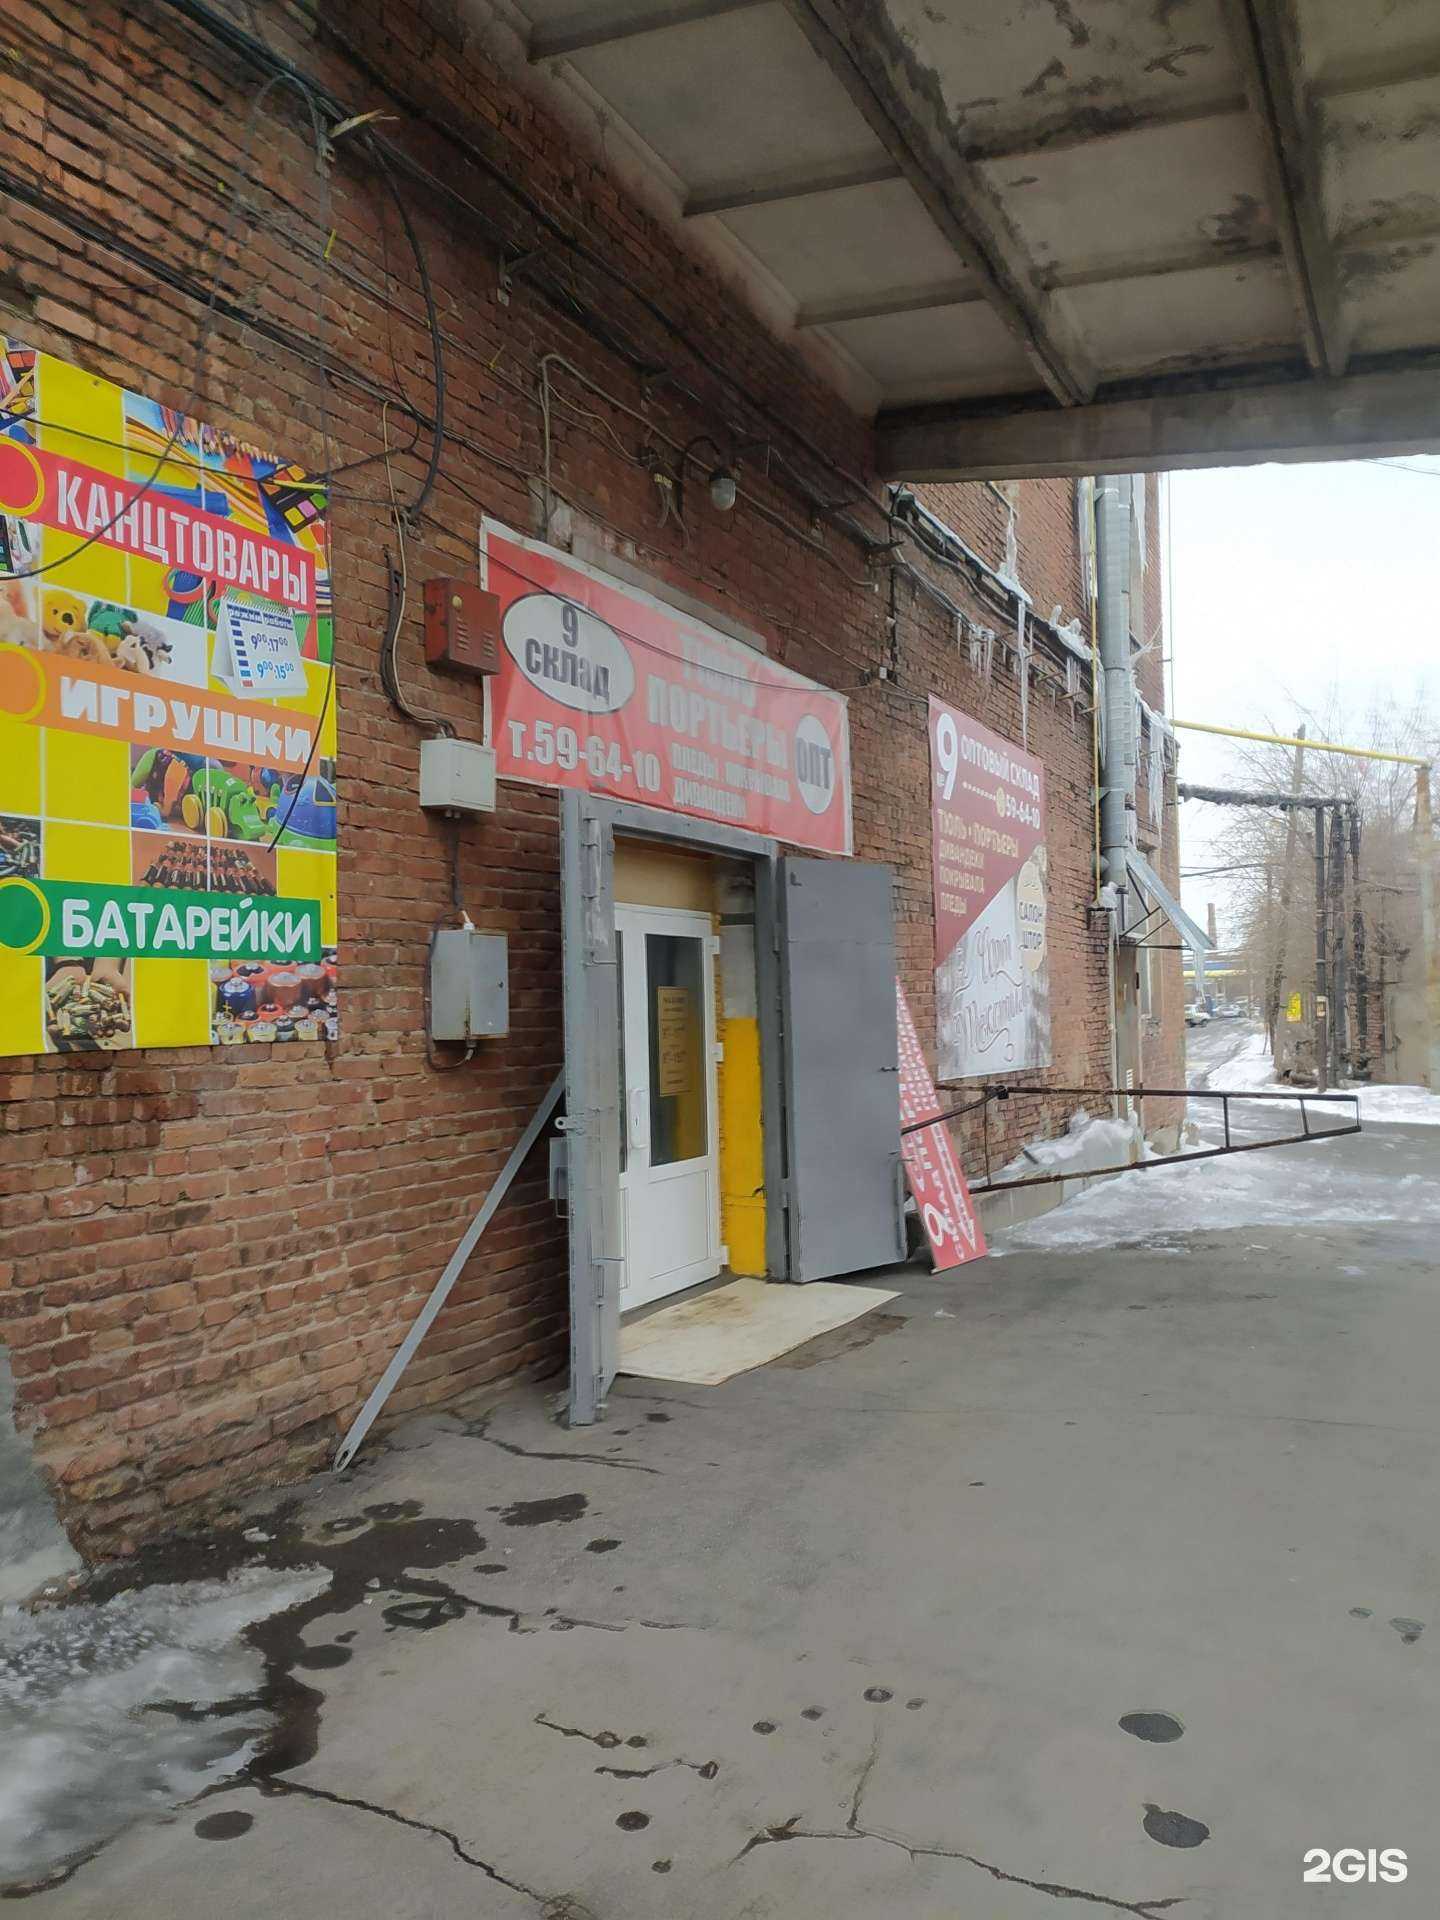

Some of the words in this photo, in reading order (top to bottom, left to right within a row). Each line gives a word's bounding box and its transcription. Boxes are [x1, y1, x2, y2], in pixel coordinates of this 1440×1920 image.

[57, 470, 308, 606] КАНЦТОВАРЫ
[560, 604, 579, 648] 9
[60, 675, 311, 764] ИГРУШКИ
[796, 736, 832, 791] ОПТ
[936, 713, 958, 801] 9
[62, 897, 311, 954] БАТАРЕЙКИ
